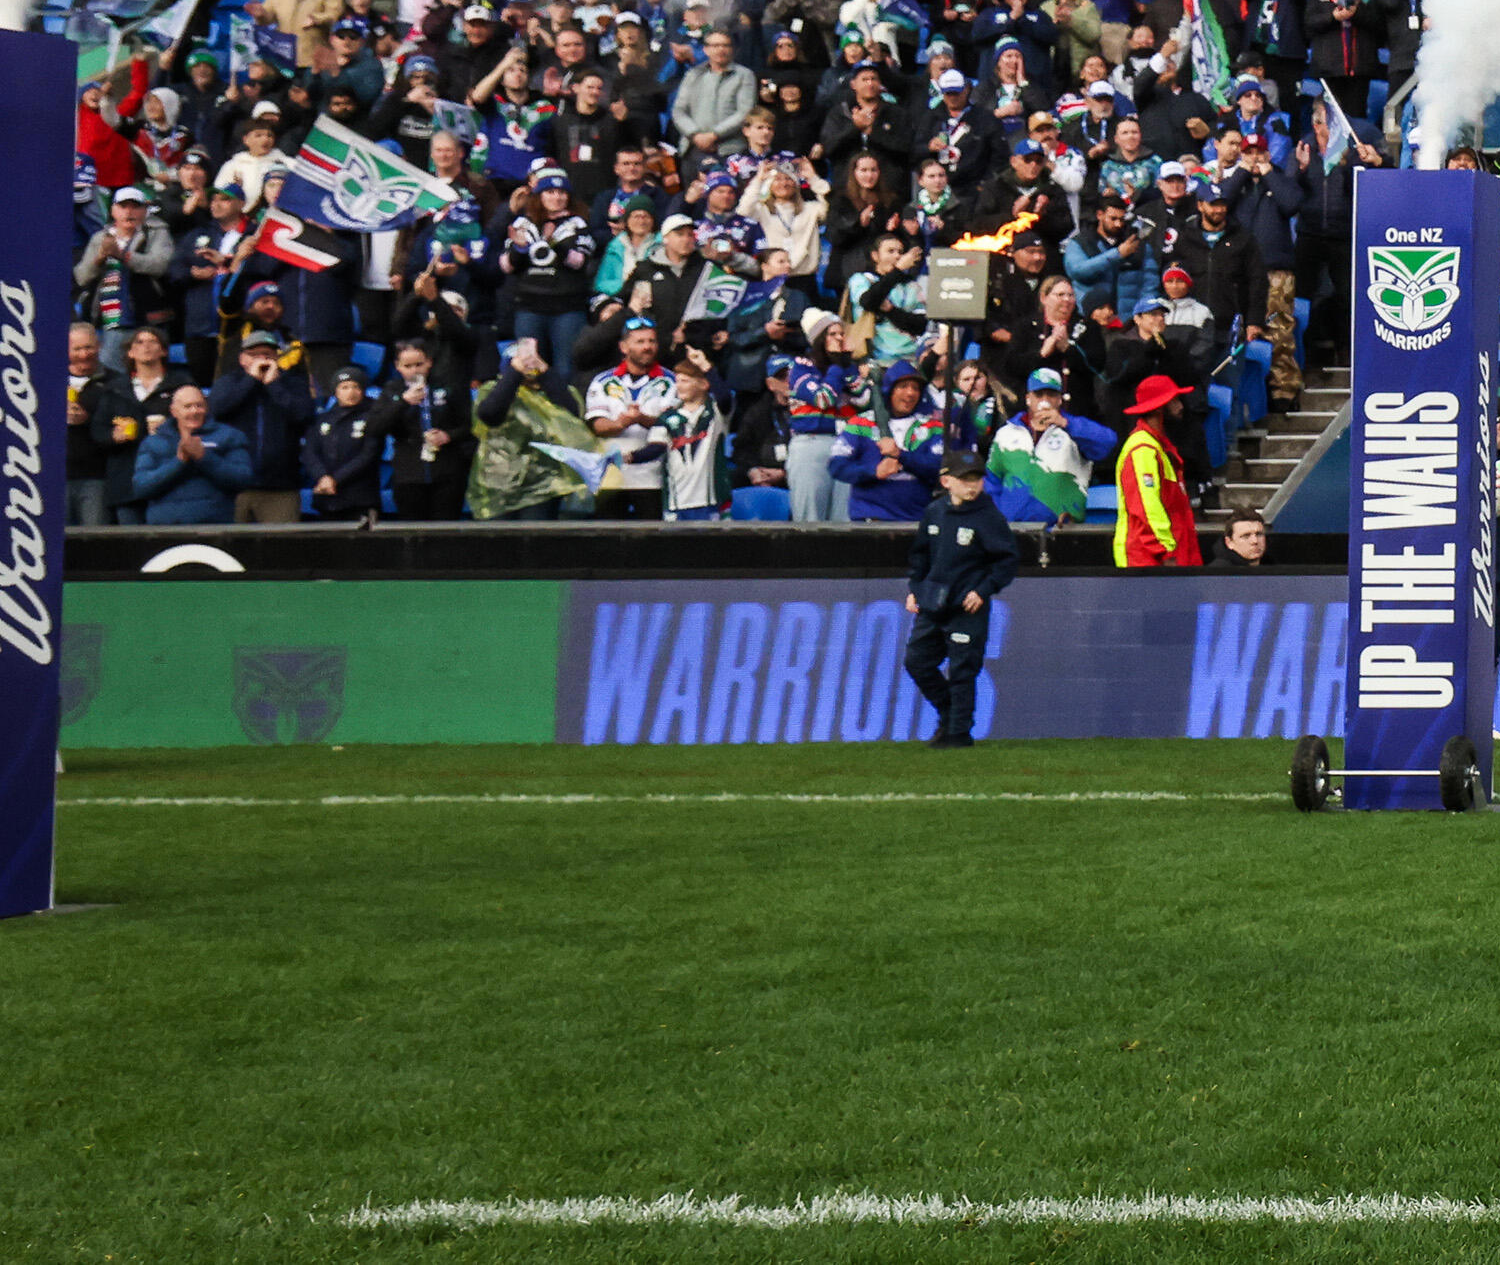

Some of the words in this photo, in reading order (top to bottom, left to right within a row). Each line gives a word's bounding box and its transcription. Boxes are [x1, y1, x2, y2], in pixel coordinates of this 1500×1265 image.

[1385, 228, 1417, 243] One
[1420, 228, 1443, 243] NZ
[1374, 319, 1452, 351] WARRIORS
[1363, 391, 1460, 531] WAHS
[1471, 350, 1494, 628] Warriors
[1360, 542, 1456, 633] THE
[1358, 644, 1455, 709] UP
